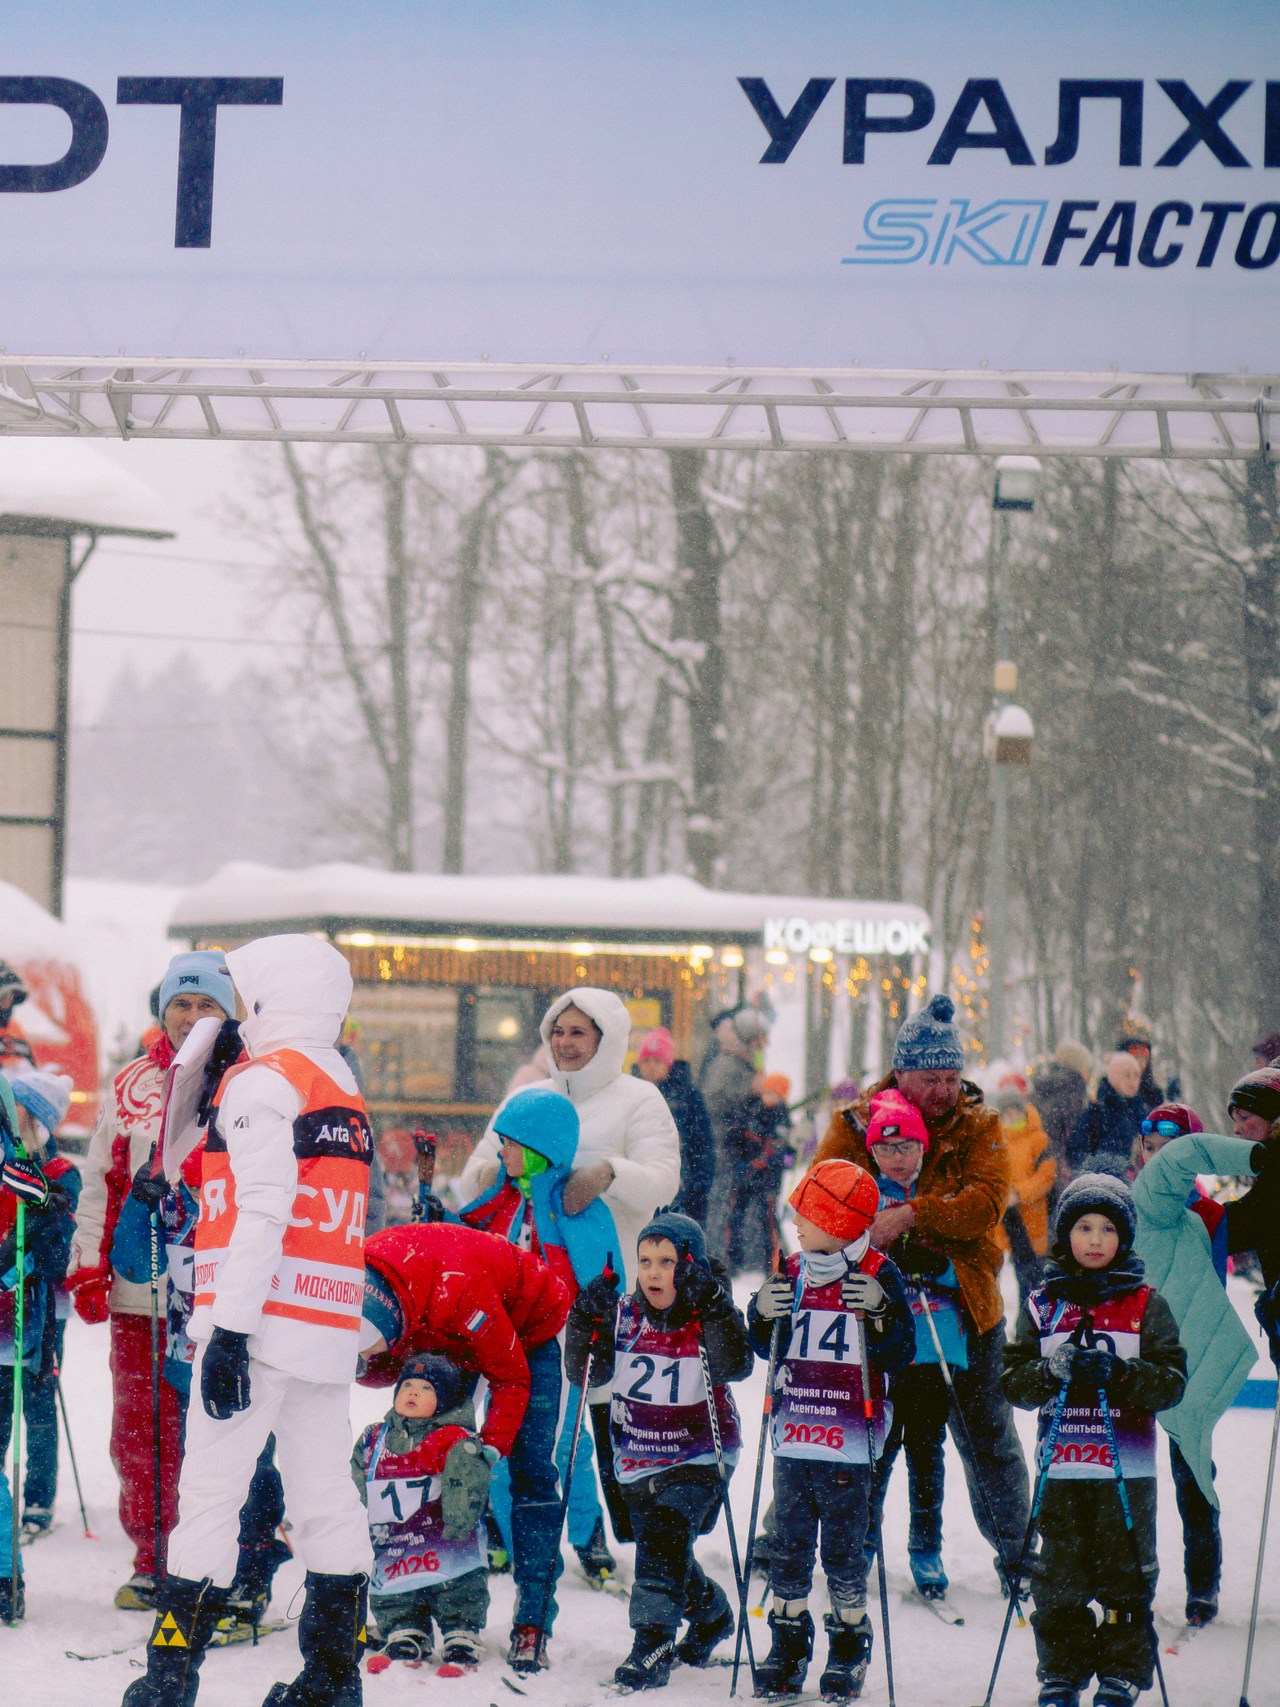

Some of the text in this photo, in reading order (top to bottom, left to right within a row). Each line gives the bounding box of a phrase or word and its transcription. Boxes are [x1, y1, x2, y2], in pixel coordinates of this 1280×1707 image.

[736, 77, 1280, 168] УРАЛХ
[840, 199, 1050, 266] SKI
[315, 1124, 349, 1143] Arta
[150, 1229, 158, 1289] NORDWAY
[794, 1311, 850, 1361] 14
[627, 1355, 681, 1404] 21
[783, 1384, 851, 1400] Вечерняя гонка
[790, 1401, 837, 1416] Акентьева
[1093, 1408, 1121, 1418] гока
[622, 1421, 689, 1440] Вечерняя гонка
[783, 1422, 844, 1449] 2026
[627, 1440, 680, 1452] Акентьева
[1051, 1443, 1113, 1468] 2026
[381, 1477, 433, 1522] 17
[384, 1550, 440, 1580] 2026
